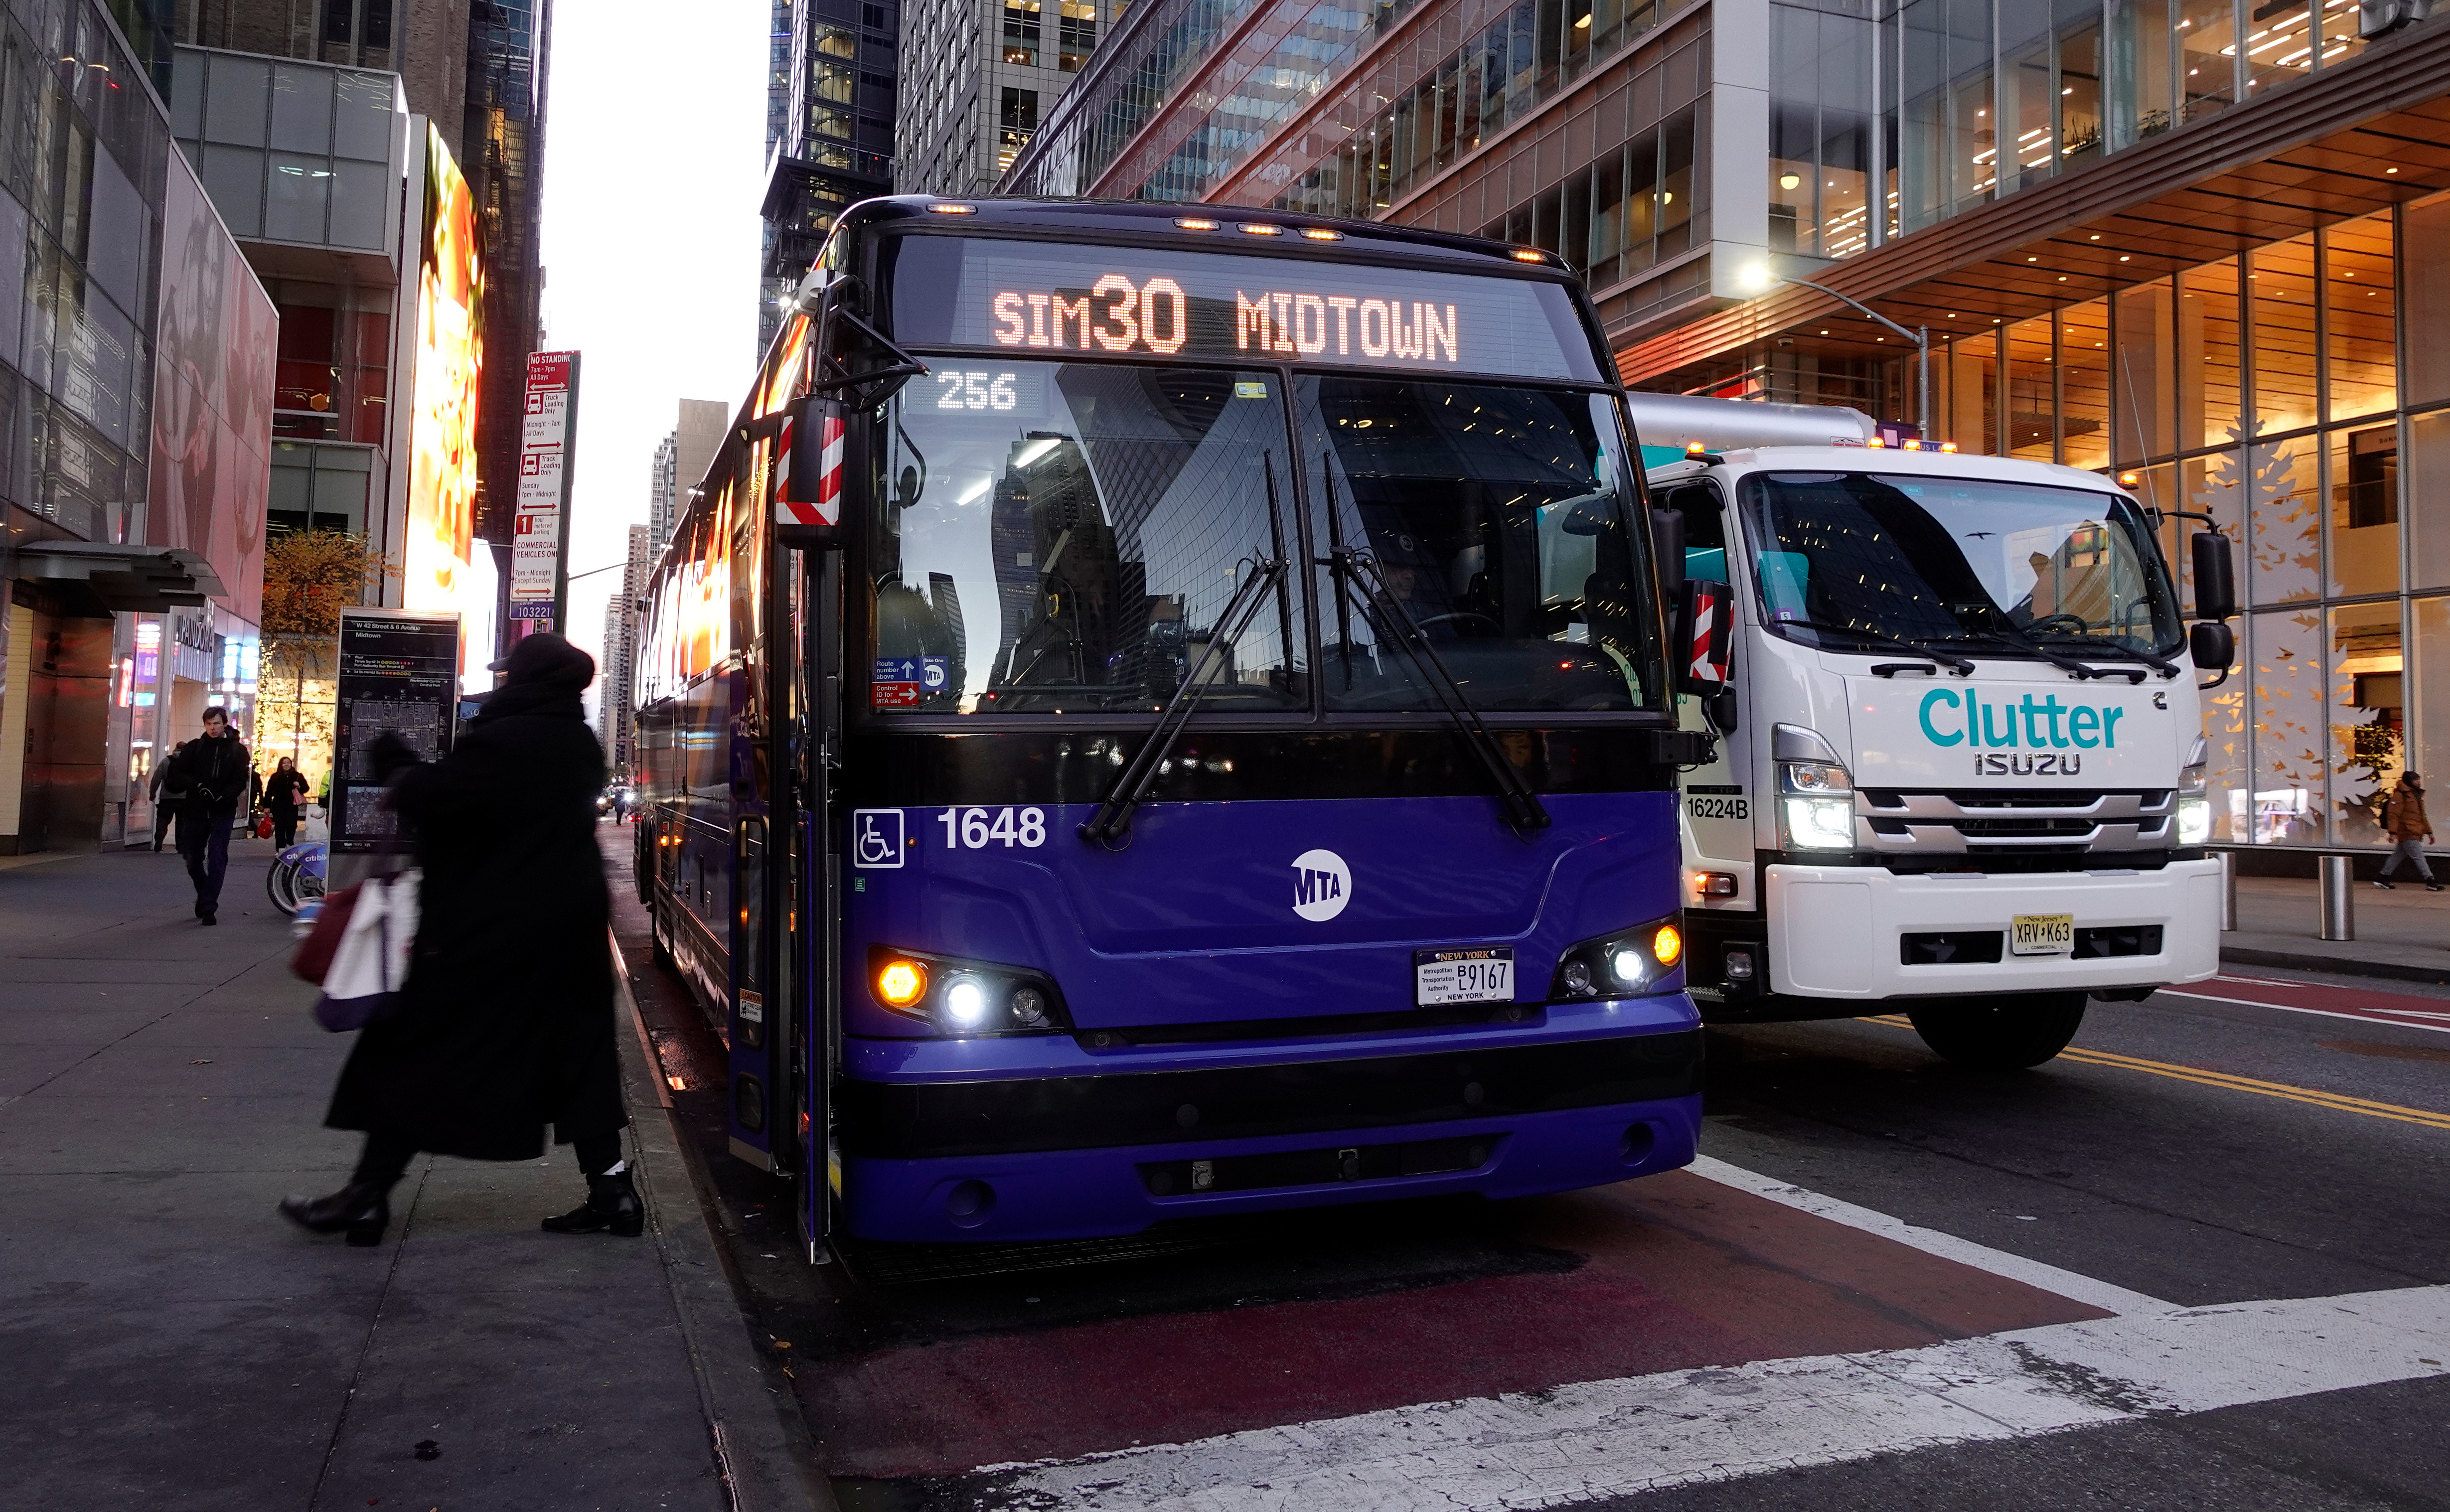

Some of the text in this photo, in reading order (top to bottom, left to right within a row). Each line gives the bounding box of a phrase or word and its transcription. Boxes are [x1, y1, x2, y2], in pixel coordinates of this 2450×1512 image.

[995, 275, 1458, 362] SIM30 MIDTOWN
[531, 356, 540, 364] NO
[938, 371, 1015, 410] 256
[521, 516, 527, 533] 1
[519, 607, 550, 617] 103221
[181, 614, 213, 653] PANDORA
[925, 670, 941, 682] MTA
[1919, 688, 2123, 748] Clutter
[1975, 752, 2081, 775] ISUZU
[1687, 797, 1748, 819] 16224B
[938, 807, 1046, 849] 1648
[1293, 866, 1341, 907] MTA
[1440, 950, 1490, 961] NEW YORK
[745, 992, 761, 1003] CAUTION
